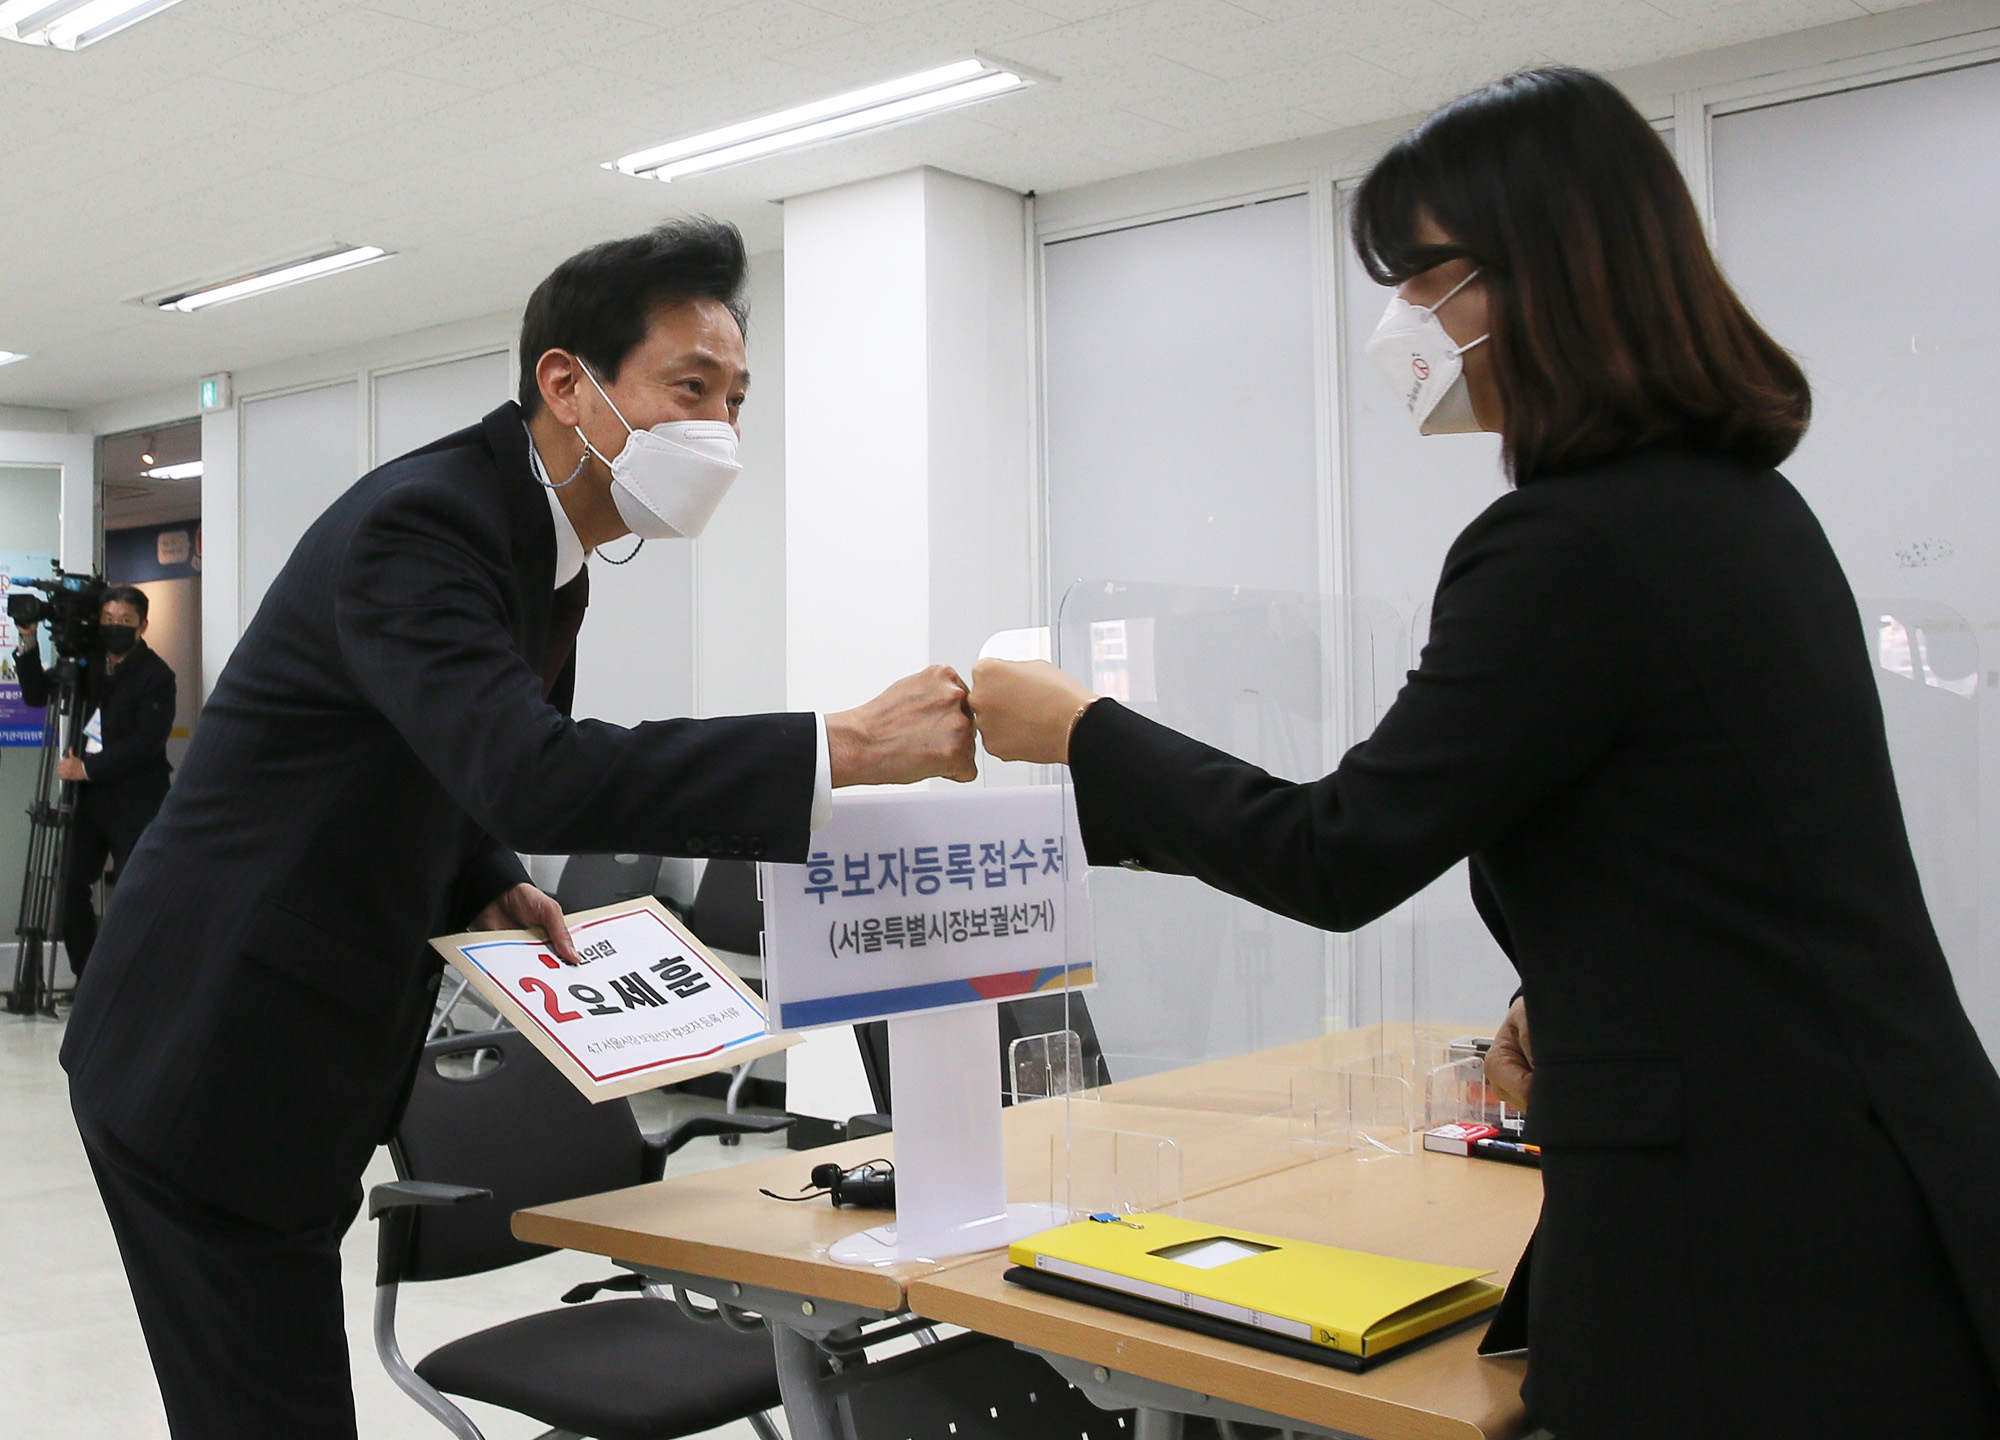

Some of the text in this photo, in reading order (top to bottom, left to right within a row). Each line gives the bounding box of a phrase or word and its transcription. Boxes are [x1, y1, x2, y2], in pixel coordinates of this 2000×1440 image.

[804, 836, 1066, 904] 후보자등록접수처
[829, 899, 1055, 958] (서울특별시장보궐선거)
[518, 955, 712, 1024] 2 오세훈
